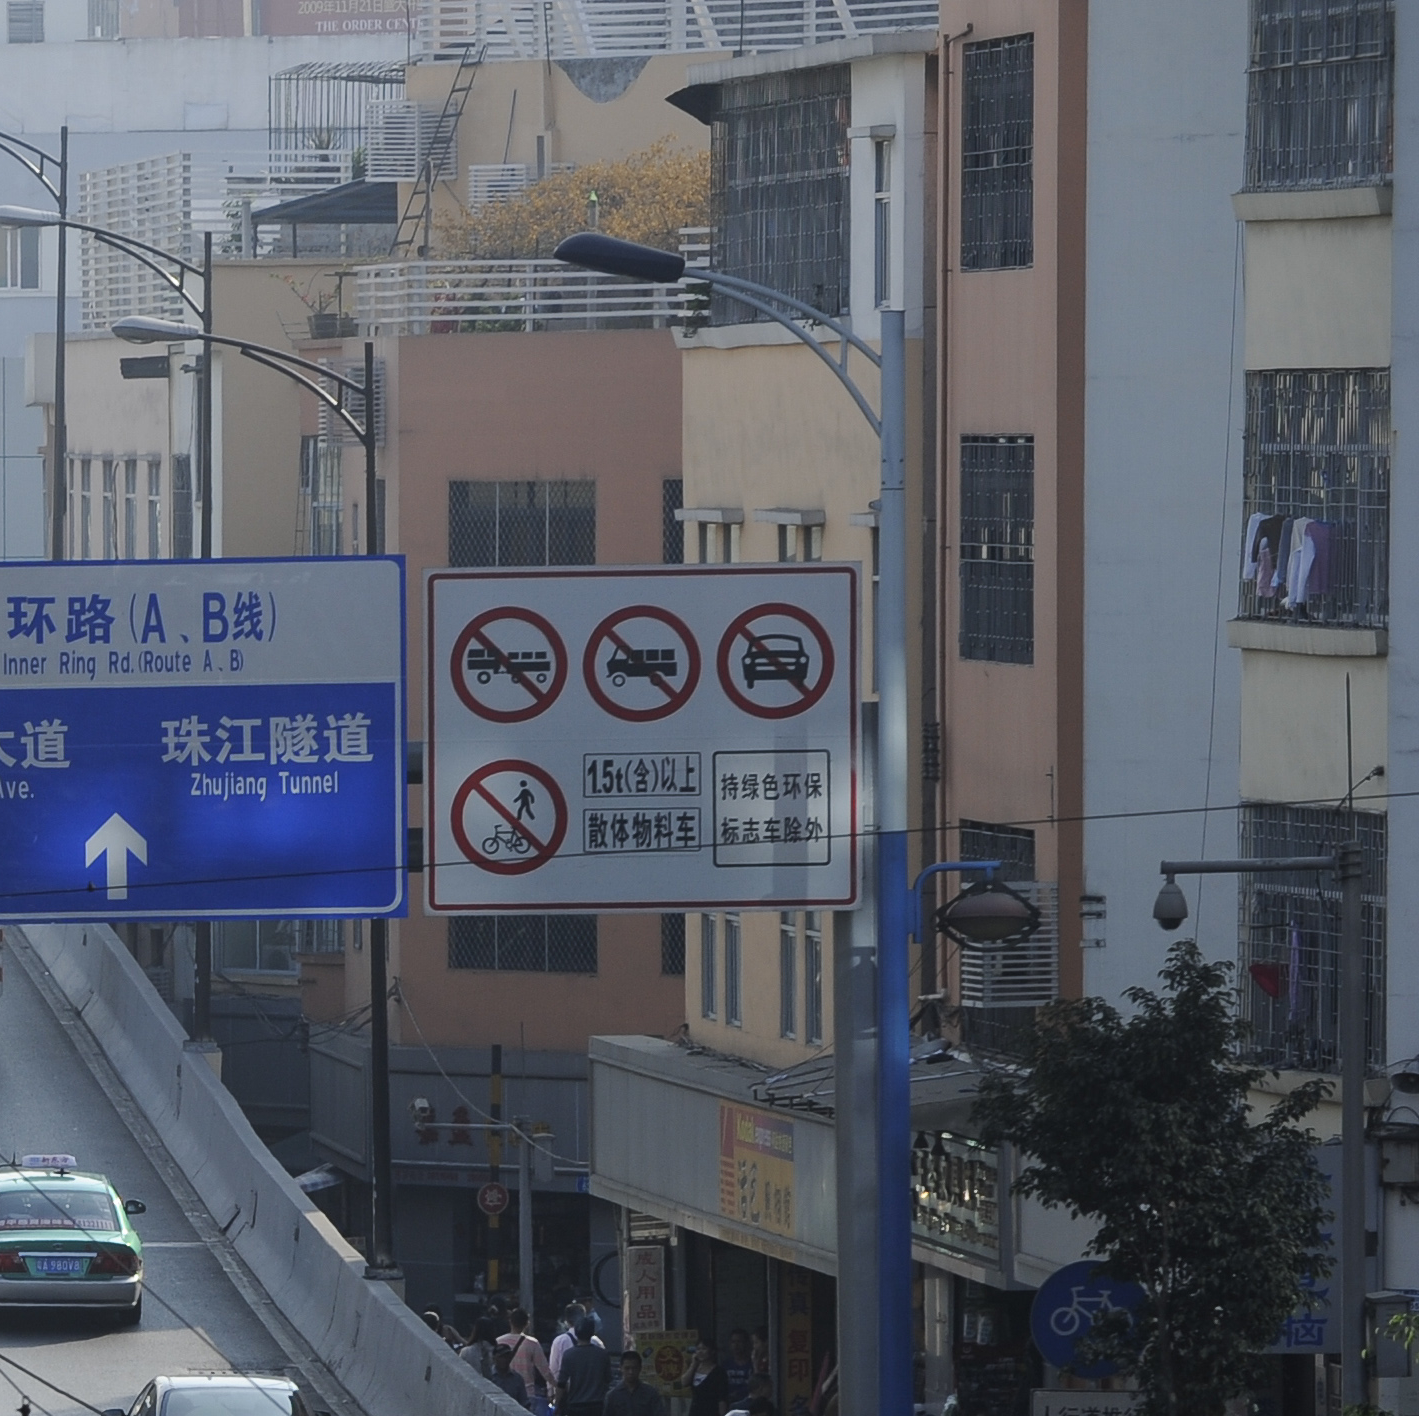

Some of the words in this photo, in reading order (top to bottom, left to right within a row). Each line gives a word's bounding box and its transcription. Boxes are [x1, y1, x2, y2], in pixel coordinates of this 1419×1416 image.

[315, 21, 340, 32] THE
[342, 19, 383, 32] ORDER
[3, 652, 47, 676] Inner
[59, 651, 97, 679] Ring
[161, 712, 374, 767] 珠江隧道
[191, 772, 267, 801] Zhujiang
[279, 770, 339, 795] Tunnel
[721, 773, 823, 801] 持绿色环保
[588, 812, 696, 850] 散体物料车
[721, 816, 824, 845] 标志车除外
[636, 1251, 657, 1319] 成人用品
